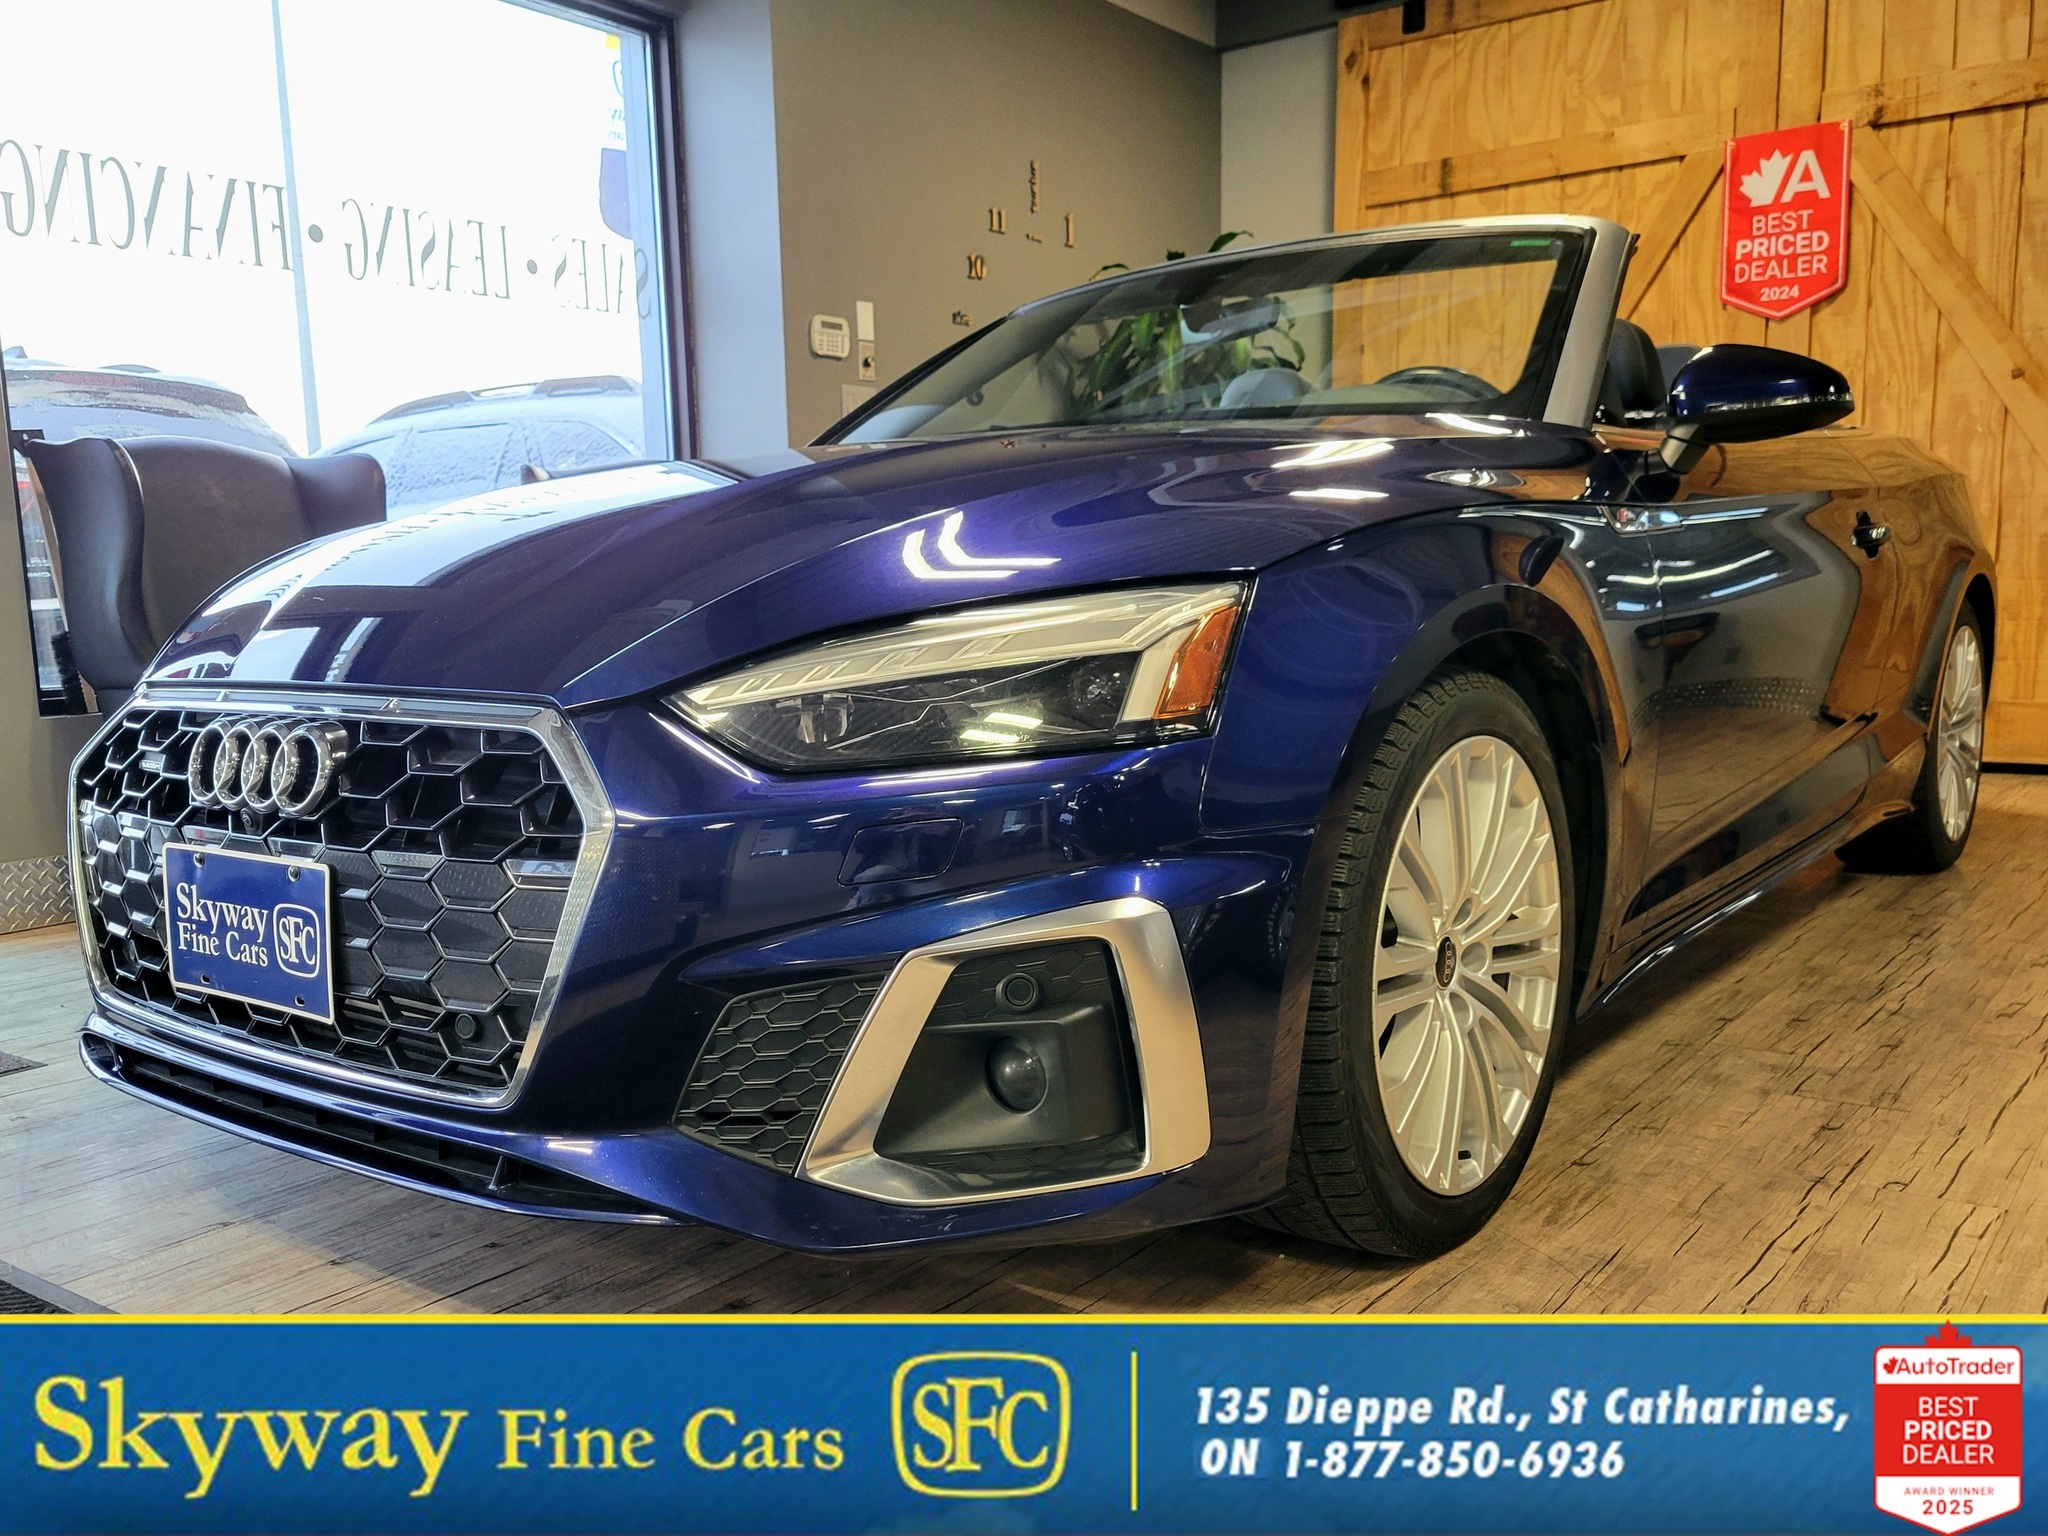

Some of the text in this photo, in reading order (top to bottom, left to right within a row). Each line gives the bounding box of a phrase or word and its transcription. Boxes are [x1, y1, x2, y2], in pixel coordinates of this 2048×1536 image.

[1752, 208, 1814, 237] BEST
[1735, 230, 1830, 261] PRICED
[966, 252, 988, 281] 10
[1734, 255, 1828, 284] DEALER
[1759, 284, 1800, 302] 2024
[176, 882, 268, 943] Skyway
[177, 921, 269, 967] Fine Cars
[279, 916, 316, 965] SFC
